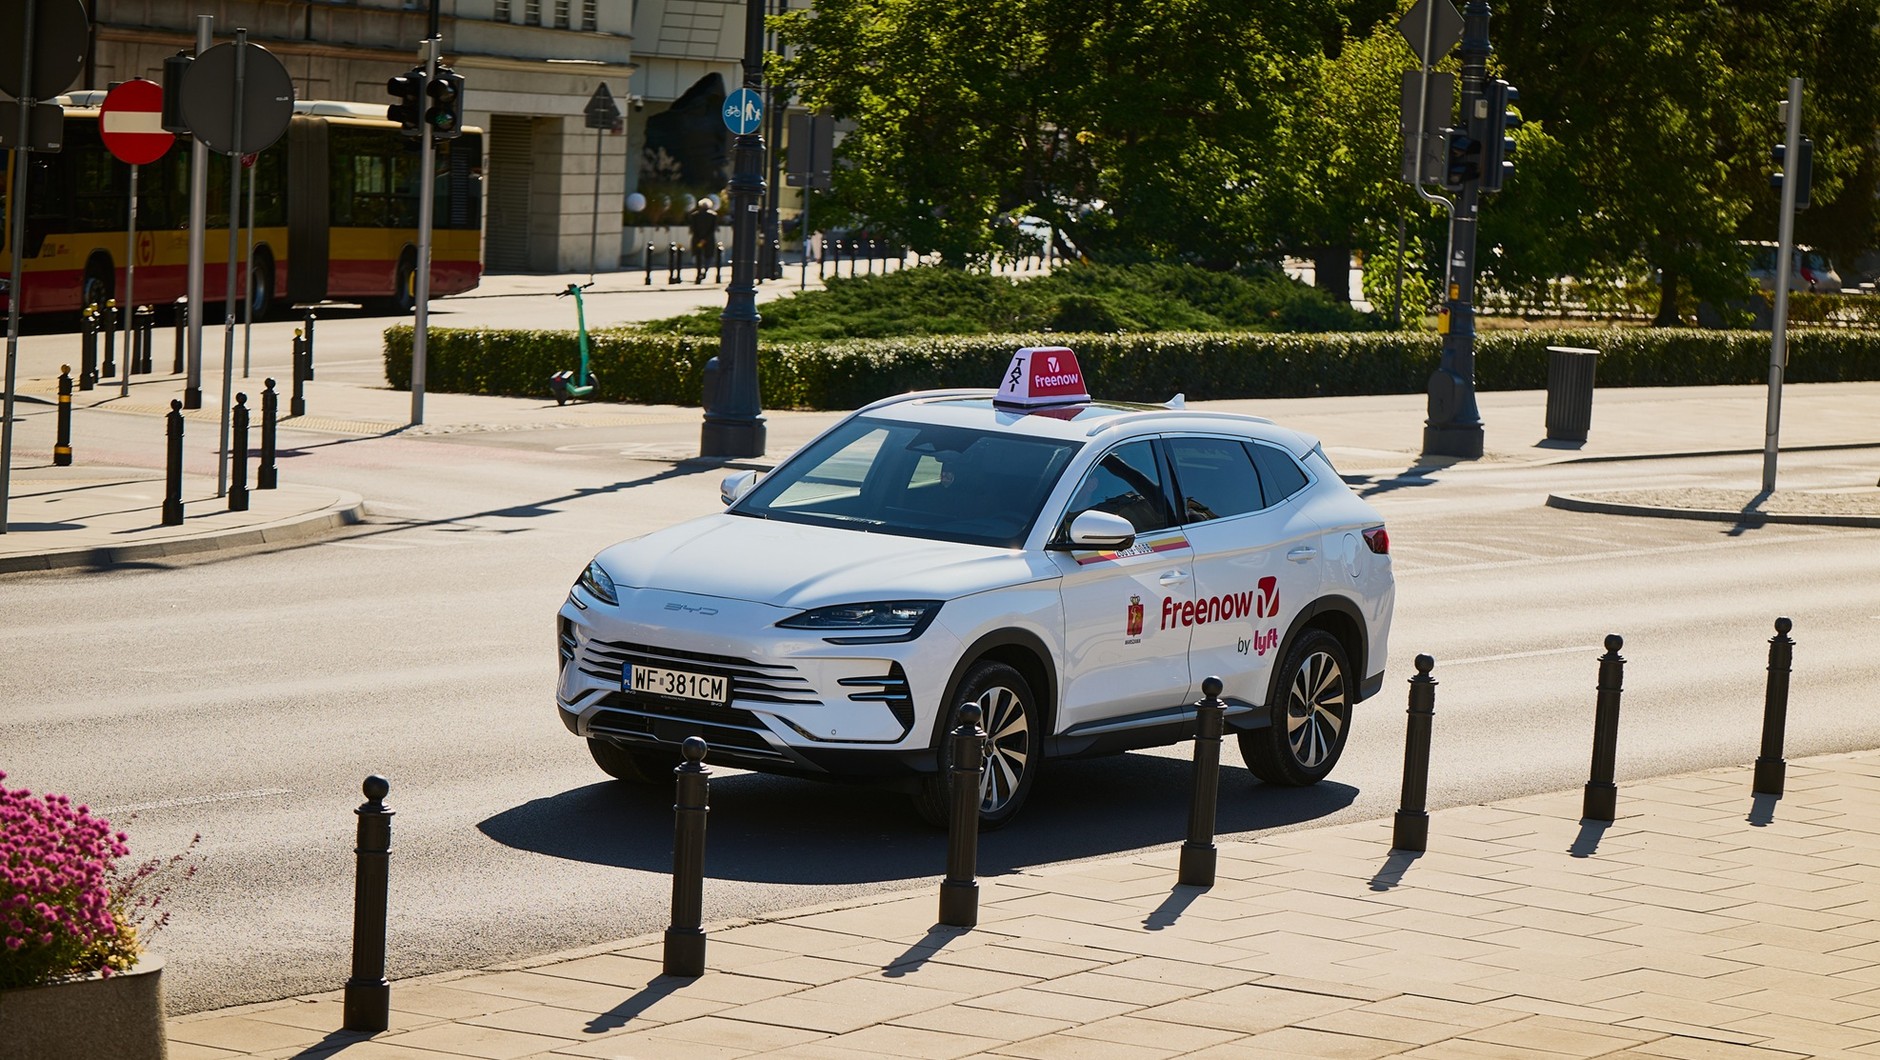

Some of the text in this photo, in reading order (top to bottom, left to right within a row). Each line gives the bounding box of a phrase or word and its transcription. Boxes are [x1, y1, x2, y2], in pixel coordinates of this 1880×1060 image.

[1008, 357, 1025, 392] TAXI
[1034, 373, 1078, 388] freenow
[664, 603, 718, 615] BYD
[1161, 591, 1253, 630] freenow
[1238, 628, 1278, 656] by lyft
[635, 667, 723, 700] WF 381CM
